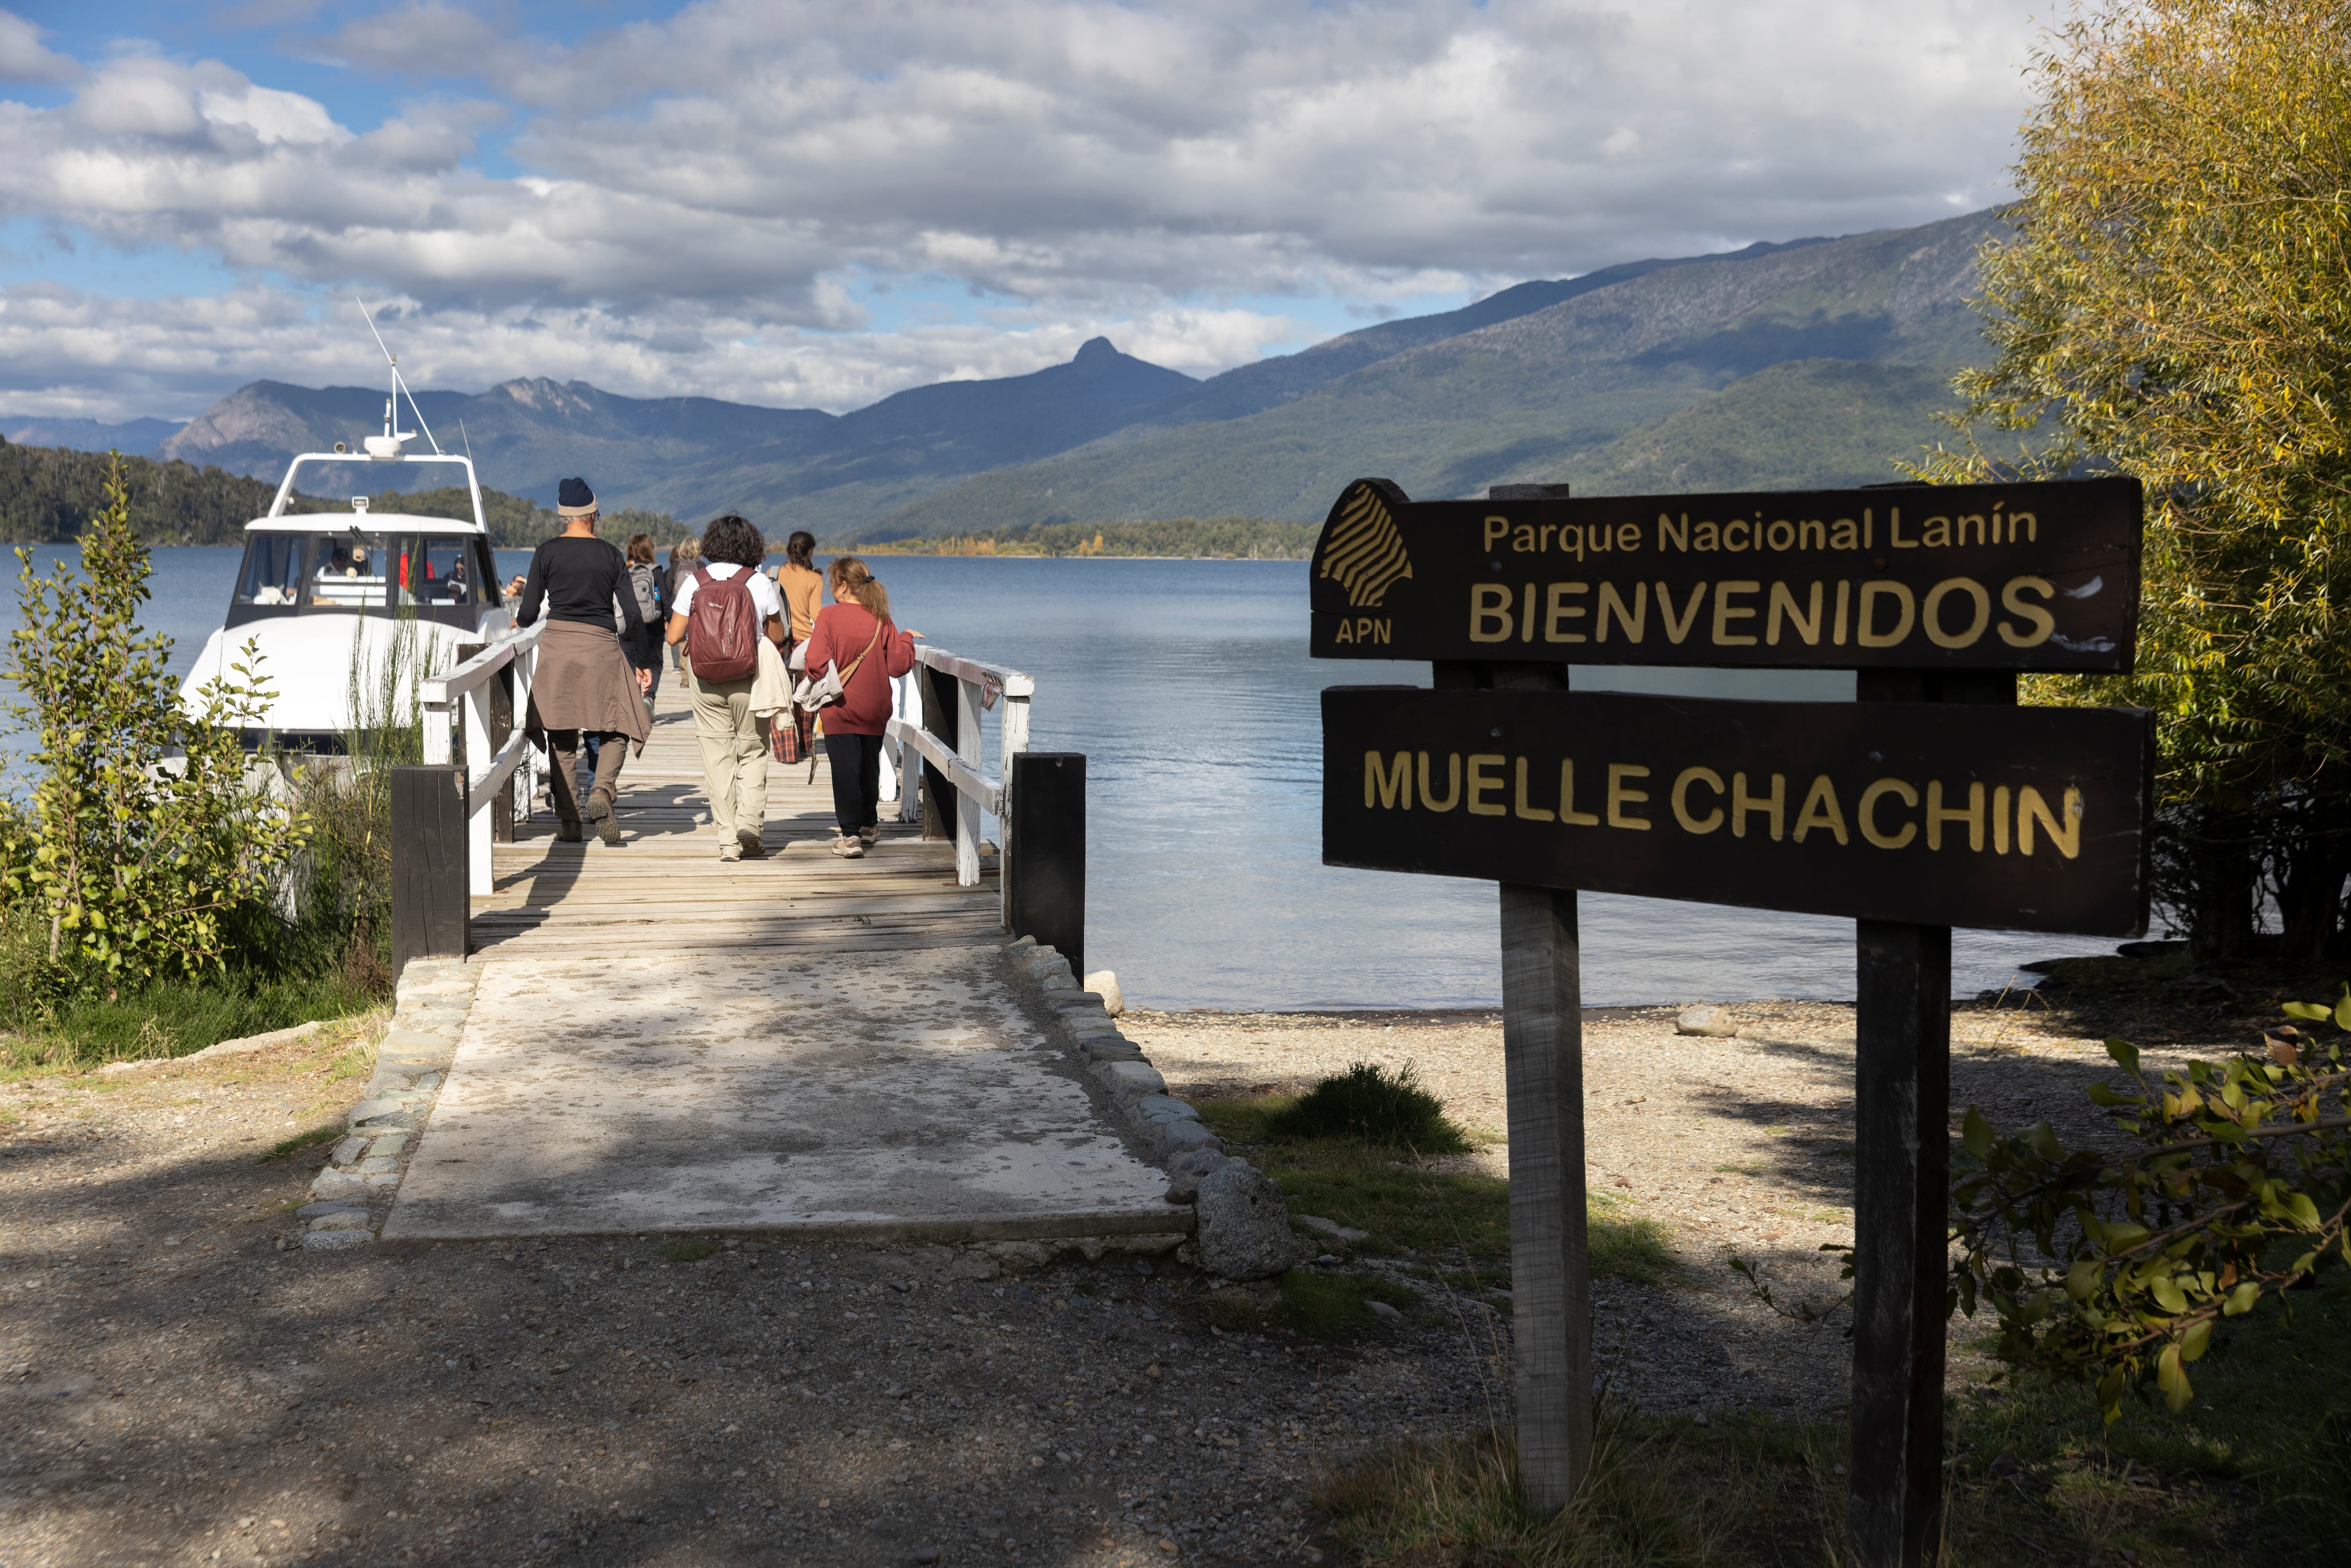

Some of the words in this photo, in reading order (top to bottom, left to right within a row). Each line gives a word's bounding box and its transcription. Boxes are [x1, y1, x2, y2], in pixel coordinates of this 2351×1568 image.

[1484, 516, 1642, 562] Parque
[1658, 508, 1872, 552] Nacional
[1891, 501, 2037, 548] Lanín
[1335, 617, 1392, 644] APN
[1469, 576, 2055, 648] BIENVENIDOS
[1364, 751, 1652, 831] MUELLE
[1671, 766, 2083, 860] CHACHIN
